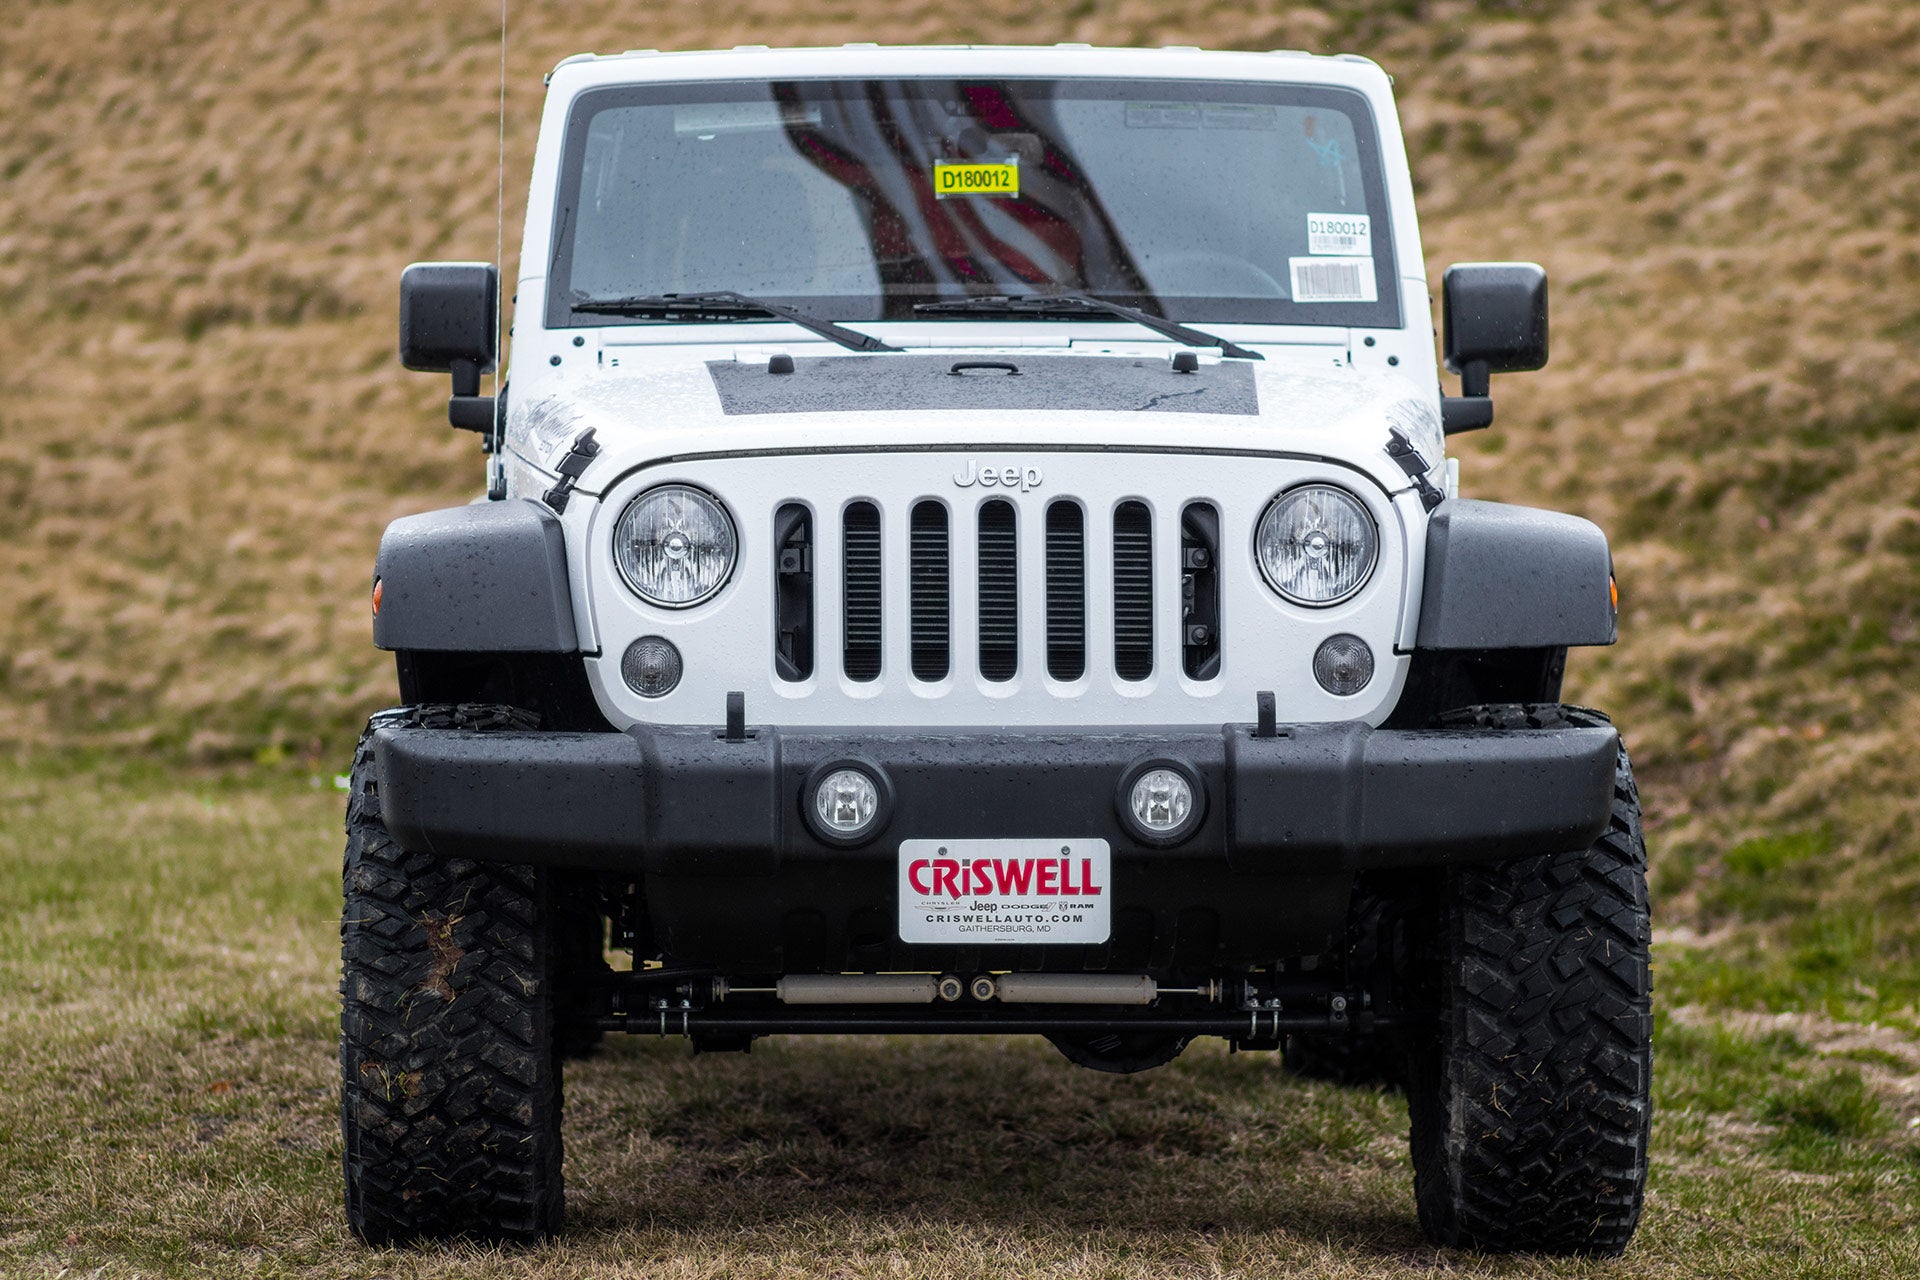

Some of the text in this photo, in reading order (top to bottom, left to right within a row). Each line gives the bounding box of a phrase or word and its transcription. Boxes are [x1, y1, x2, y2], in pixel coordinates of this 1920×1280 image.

[943, 170, 1009, 188] D180012
[1310, 220, 1366, 235] D180012
[953, 459, 1043, 493] Jeep
[969, 900, 998, 913] Jeep
[925, 914, 1083, 923] CRISWELLAUTO.COM
[958, 925, 1034, 933] GAITHERSBURG,
